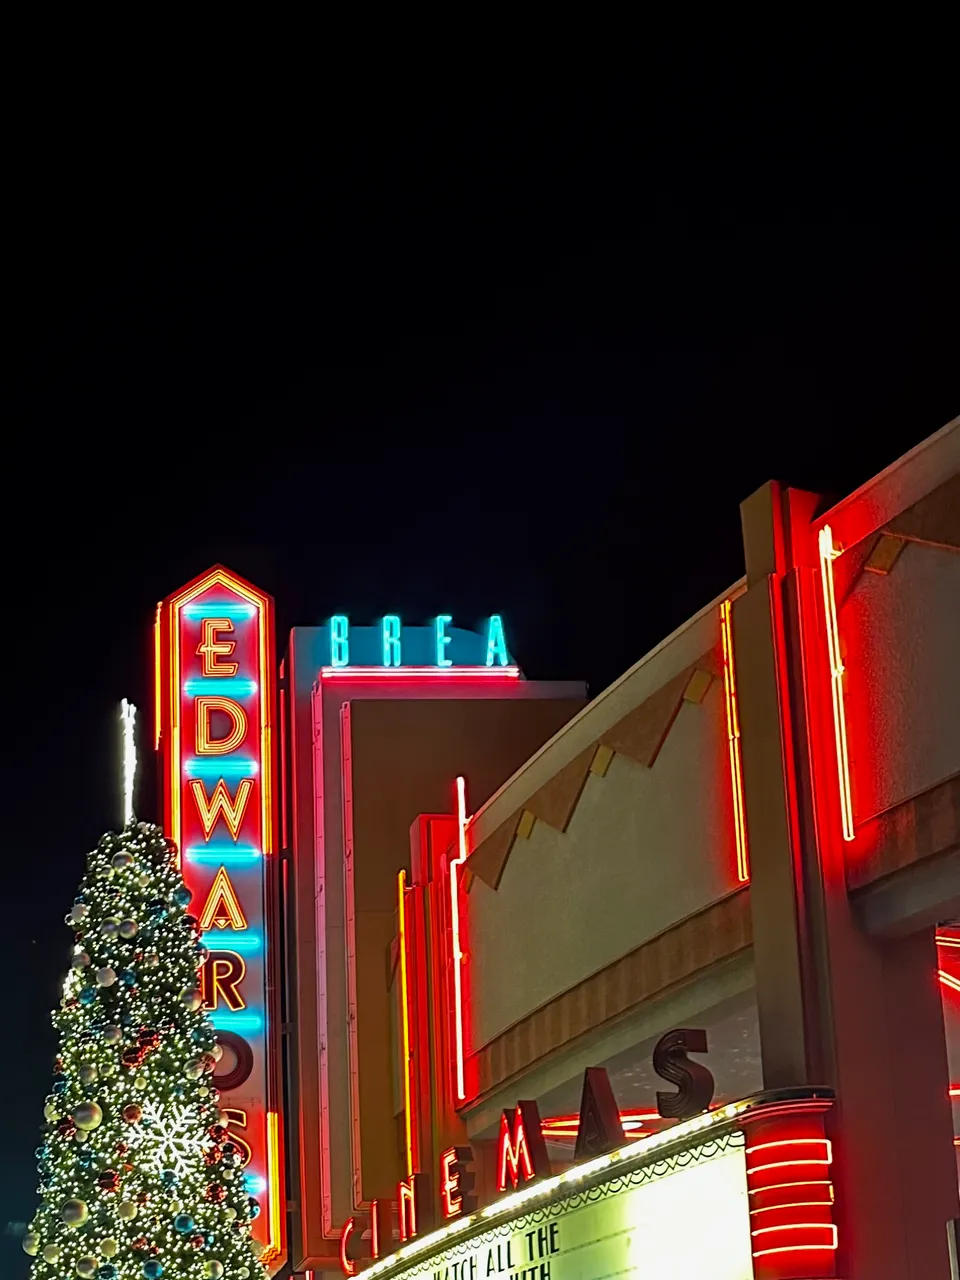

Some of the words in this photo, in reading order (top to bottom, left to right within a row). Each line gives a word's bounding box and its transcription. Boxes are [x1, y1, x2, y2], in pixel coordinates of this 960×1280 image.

[329, 614, 510, 668] BREA
[340, 1028, 716, 1276] CINEMAS
[486, 1241, 516, 1277] ALL
[525, 1222, 560, 1262] THE
